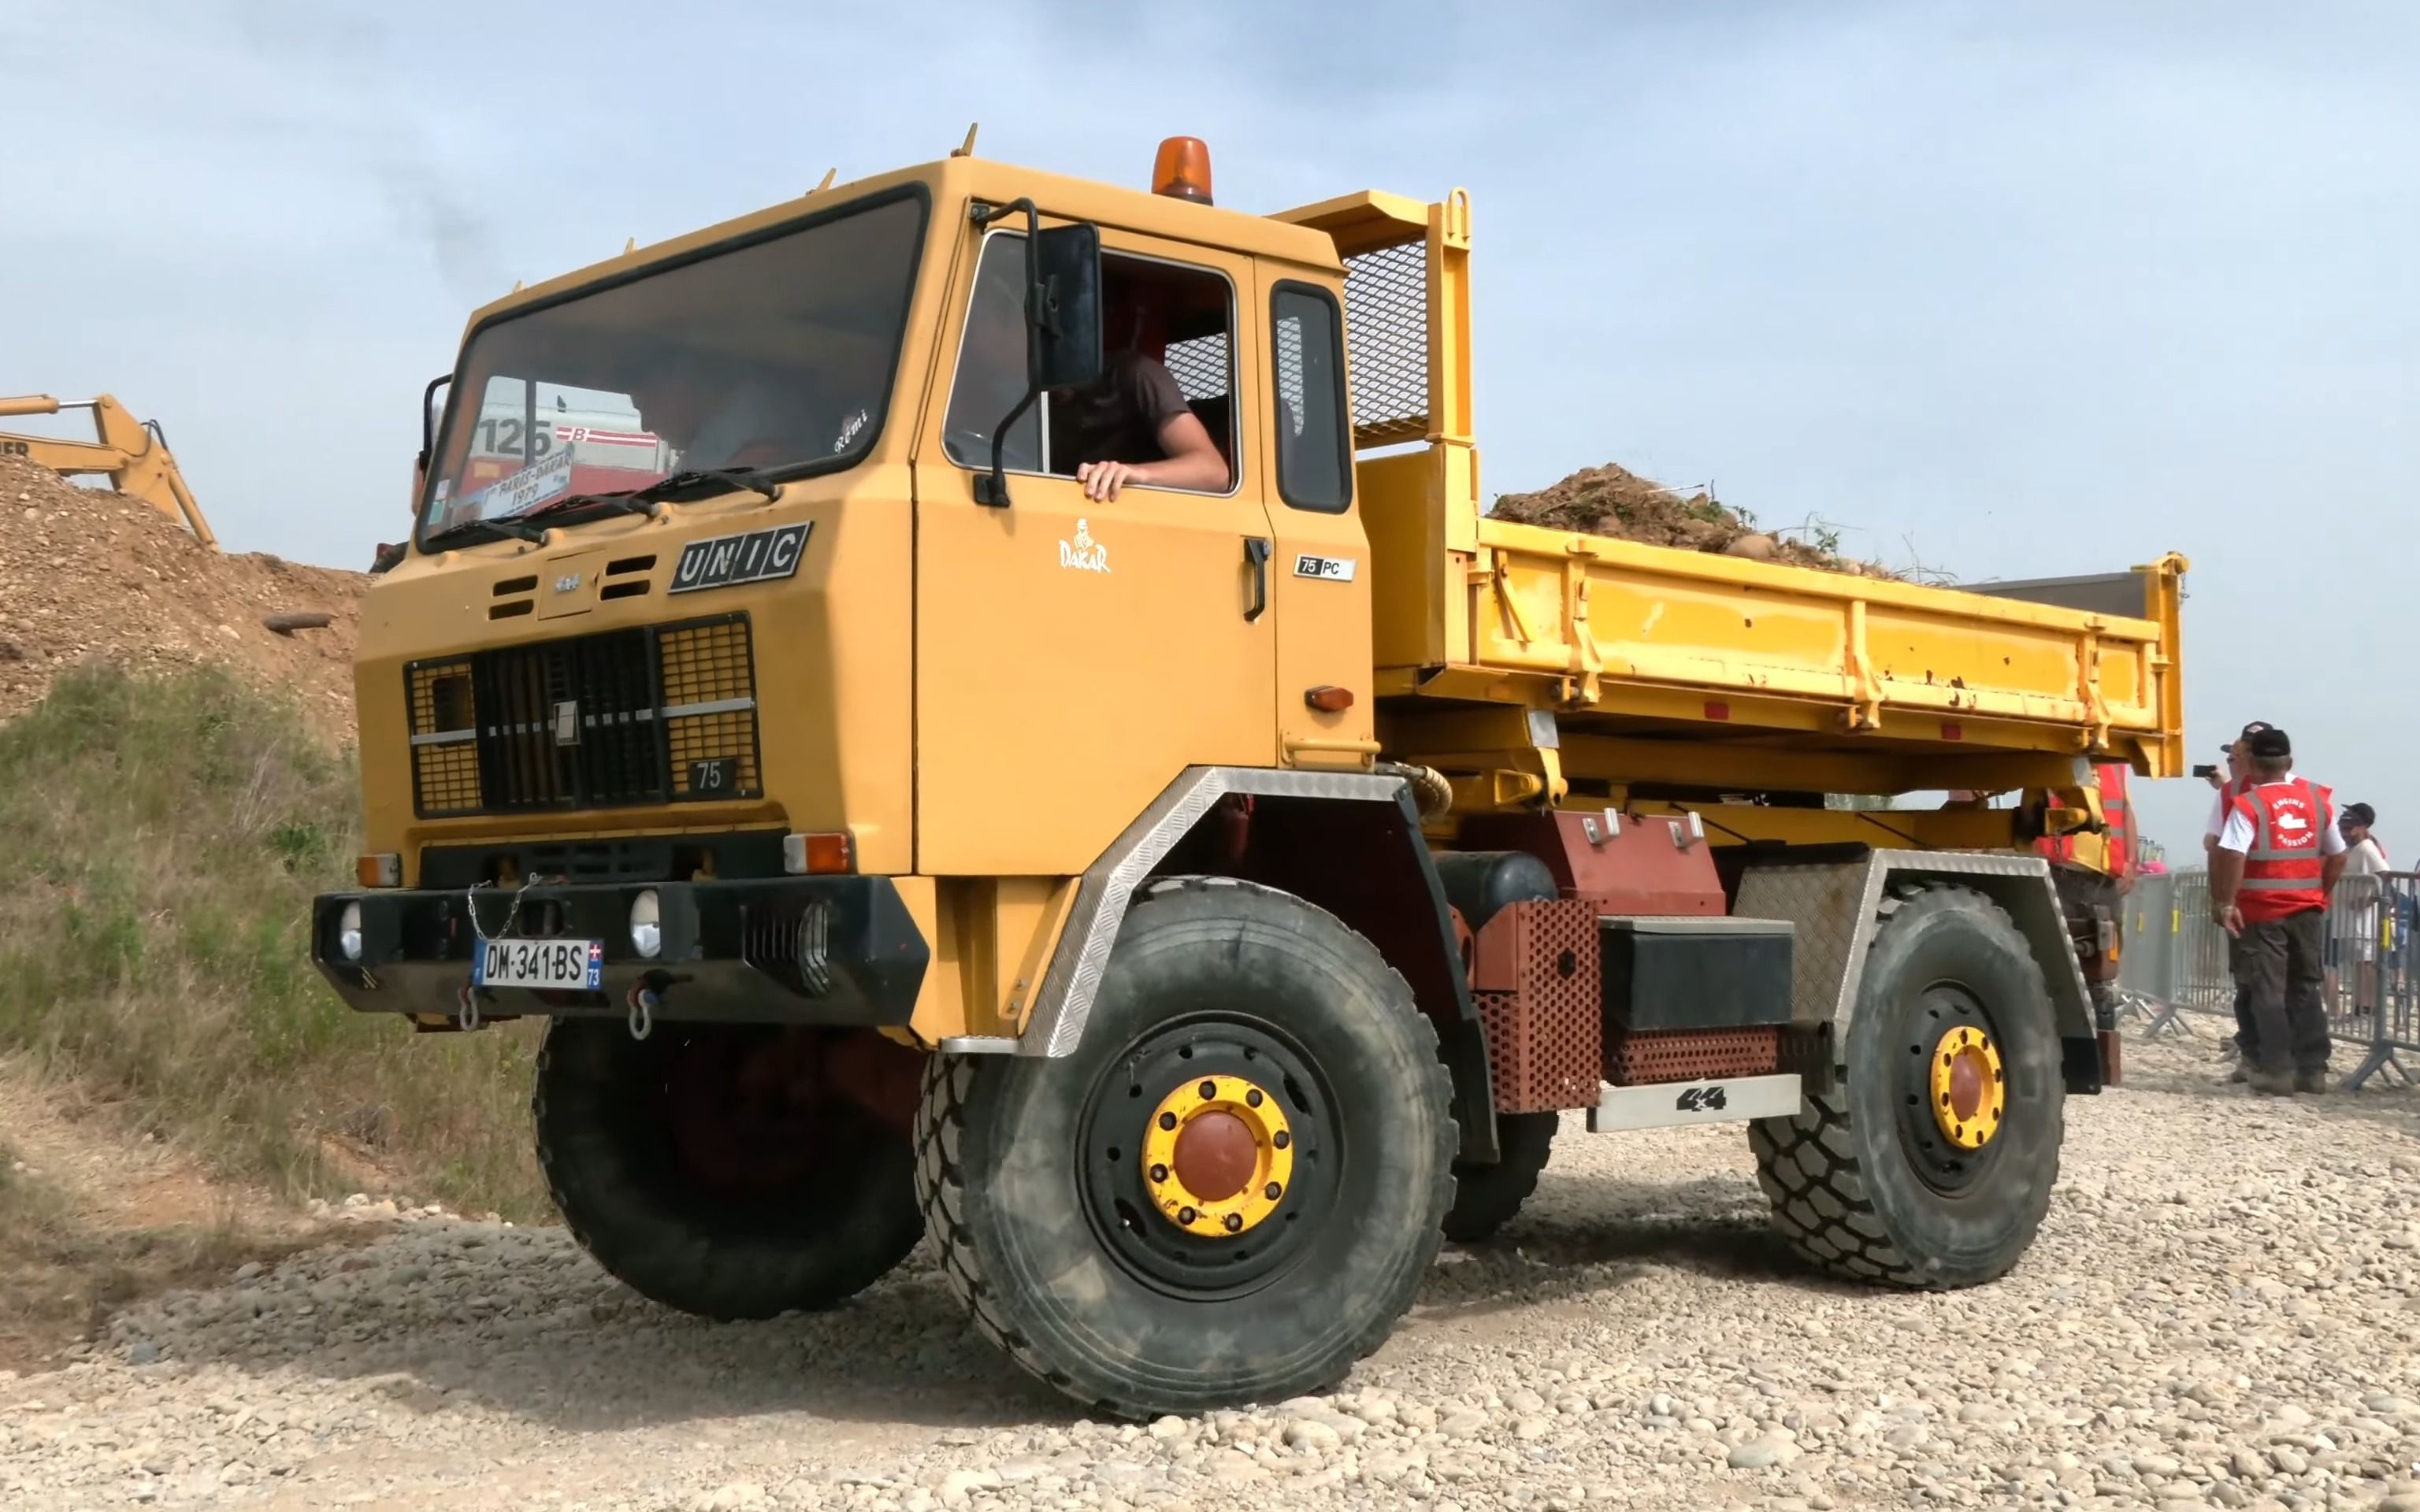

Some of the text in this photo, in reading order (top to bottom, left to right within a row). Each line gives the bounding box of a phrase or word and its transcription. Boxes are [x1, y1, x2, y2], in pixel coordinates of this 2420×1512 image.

[512, 483, 539, 506] 1979
[680, 532, 796, 582] UNIC
[1058, 538, 1112, 573] DAKAR
[1301, 558, 1340, 575] 75 PC
[696, 762, 721, 789] 75
[2272, 797, 2305, 810] ENGINS
[2277, 831, 2314, 847] PASSION
[588, 969, 599, 986] 73
